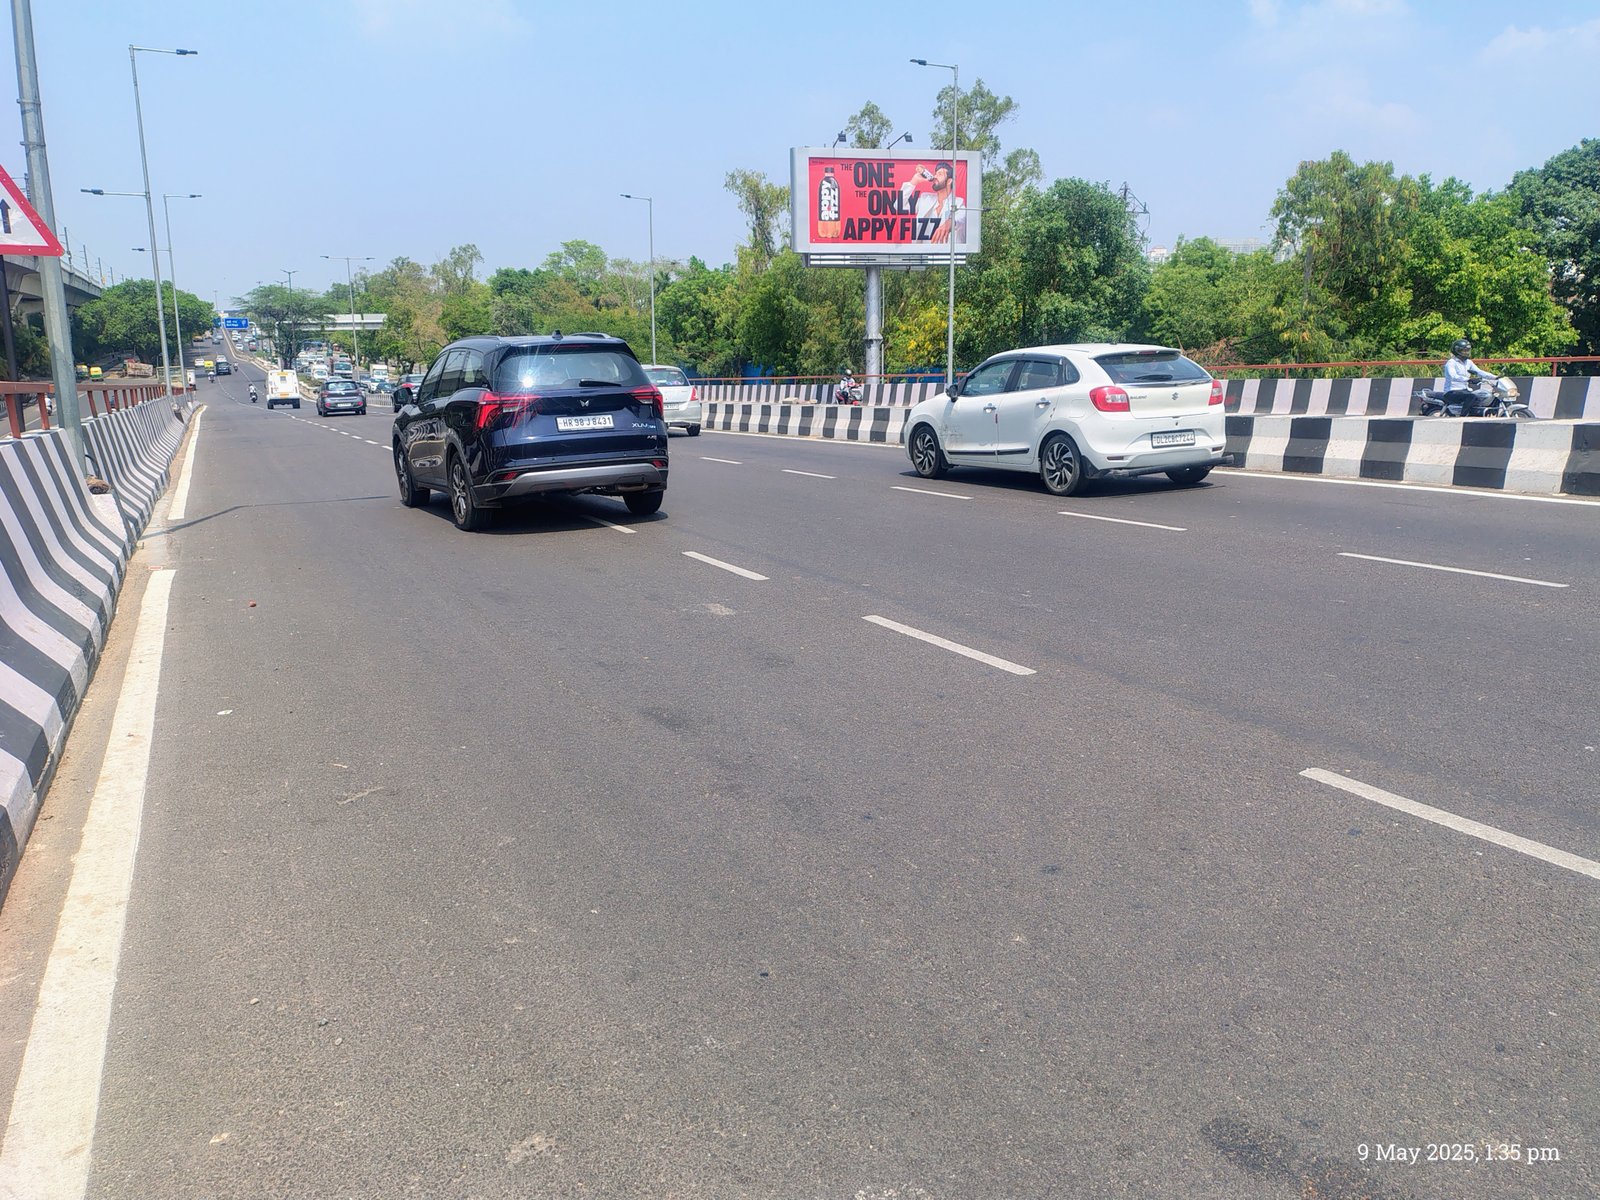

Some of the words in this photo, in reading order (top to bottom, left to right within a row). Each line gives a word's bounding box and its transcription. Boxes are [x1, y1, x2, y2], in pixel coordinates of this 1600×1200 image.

[841, 163, 853, 171] THE
[853, 162, 895, 188] ONE
[855, 190, 867, 198] THE
[868, 190, 920, 216] ONLY
[843, 218, 897, 241] APPY
[900, 218, 942, 241] FIZZ
